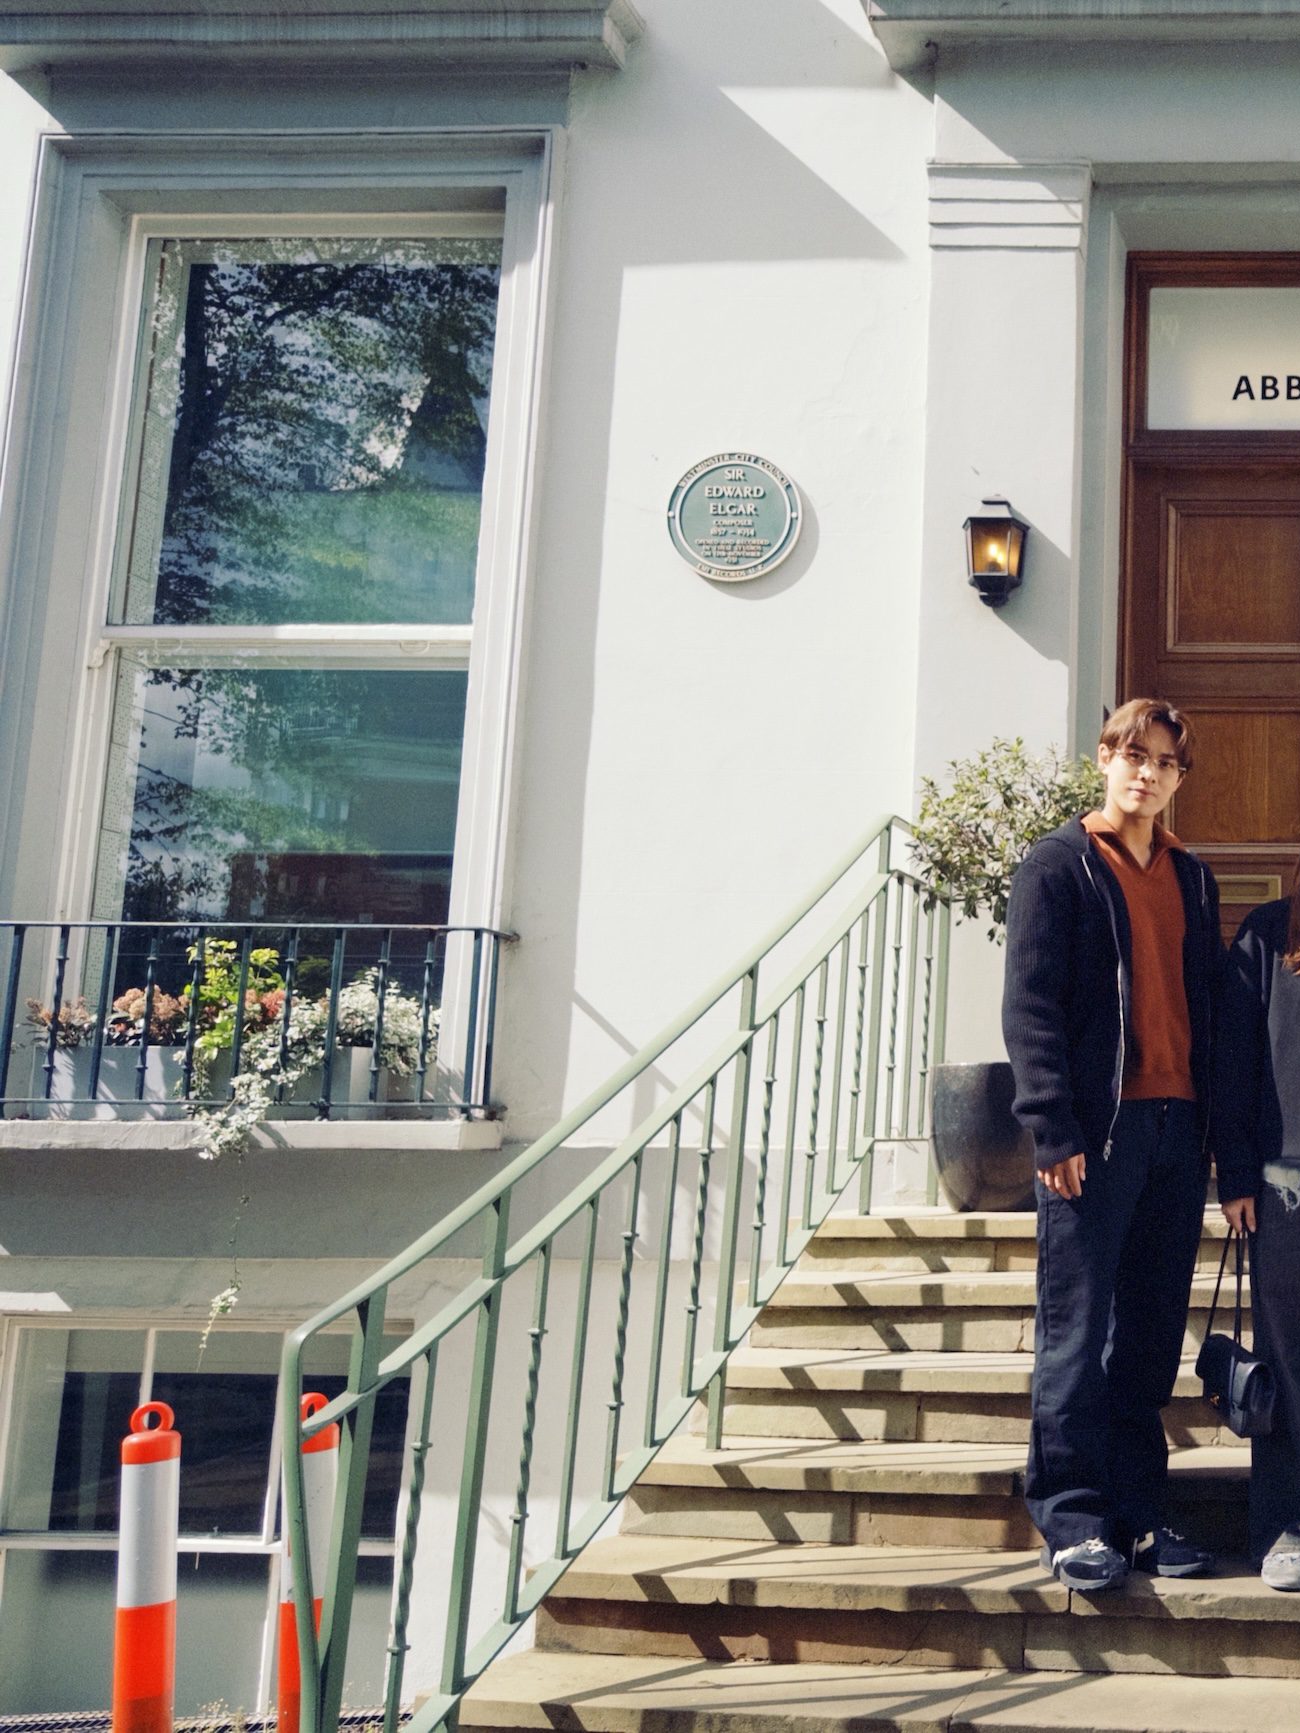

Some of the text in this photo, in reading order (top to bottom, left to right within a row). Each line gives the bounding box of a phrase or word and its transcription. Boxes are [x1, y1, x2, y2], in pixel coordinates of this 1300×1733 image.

[724, 468, 746, 481] SIR
[705, 486, 765, 498] EDWARD
[709, 503, 756, 515] ELGAR
